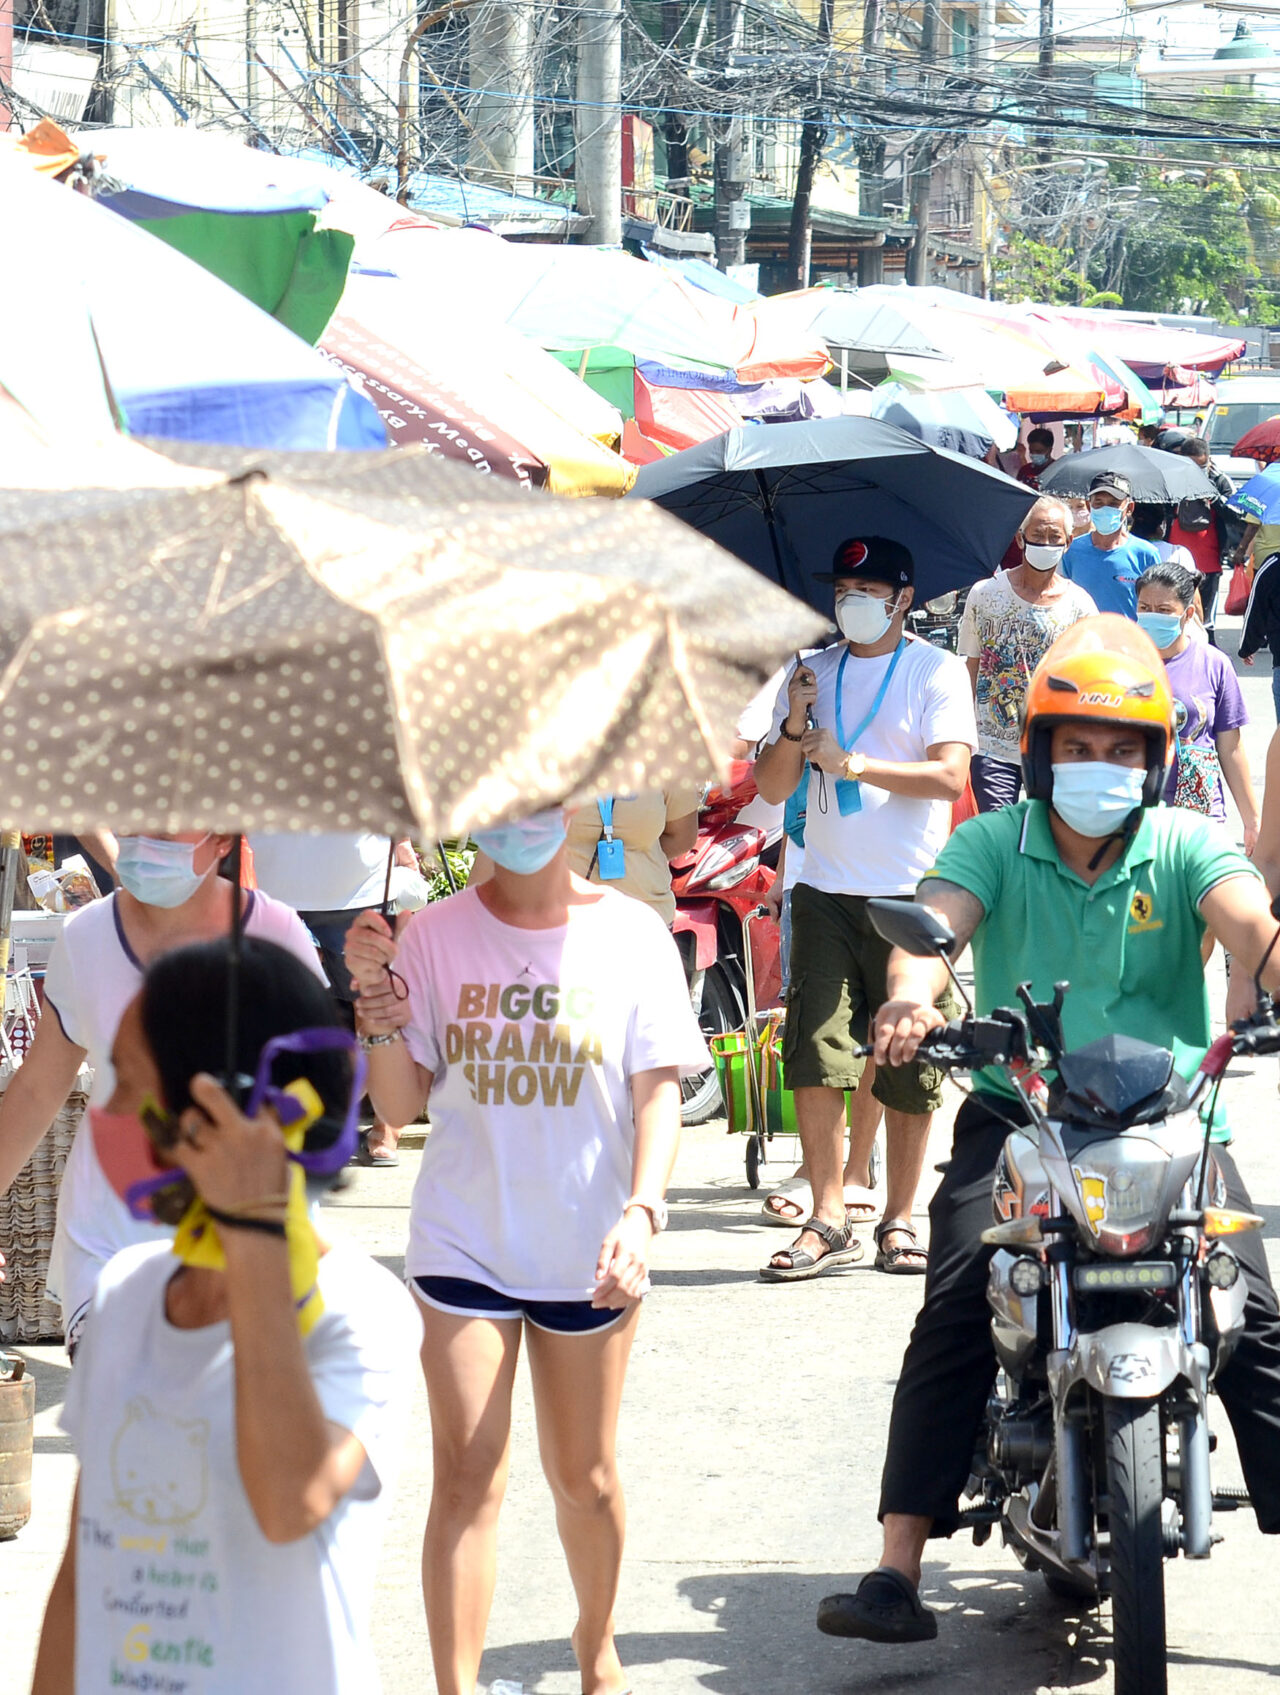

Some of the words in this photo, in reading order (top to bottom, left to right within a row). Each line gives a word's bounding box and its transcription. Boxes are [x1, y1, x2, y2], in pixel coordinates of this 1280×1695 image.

[428, 421, 498, 478] Mean
[445, 1021, 604, 1066] DRAMA
[463, 1064, 585, 1108] SHOW
[80, 1517, 115, 1549] The
[124, 1622, 214, 1667] Gentle
